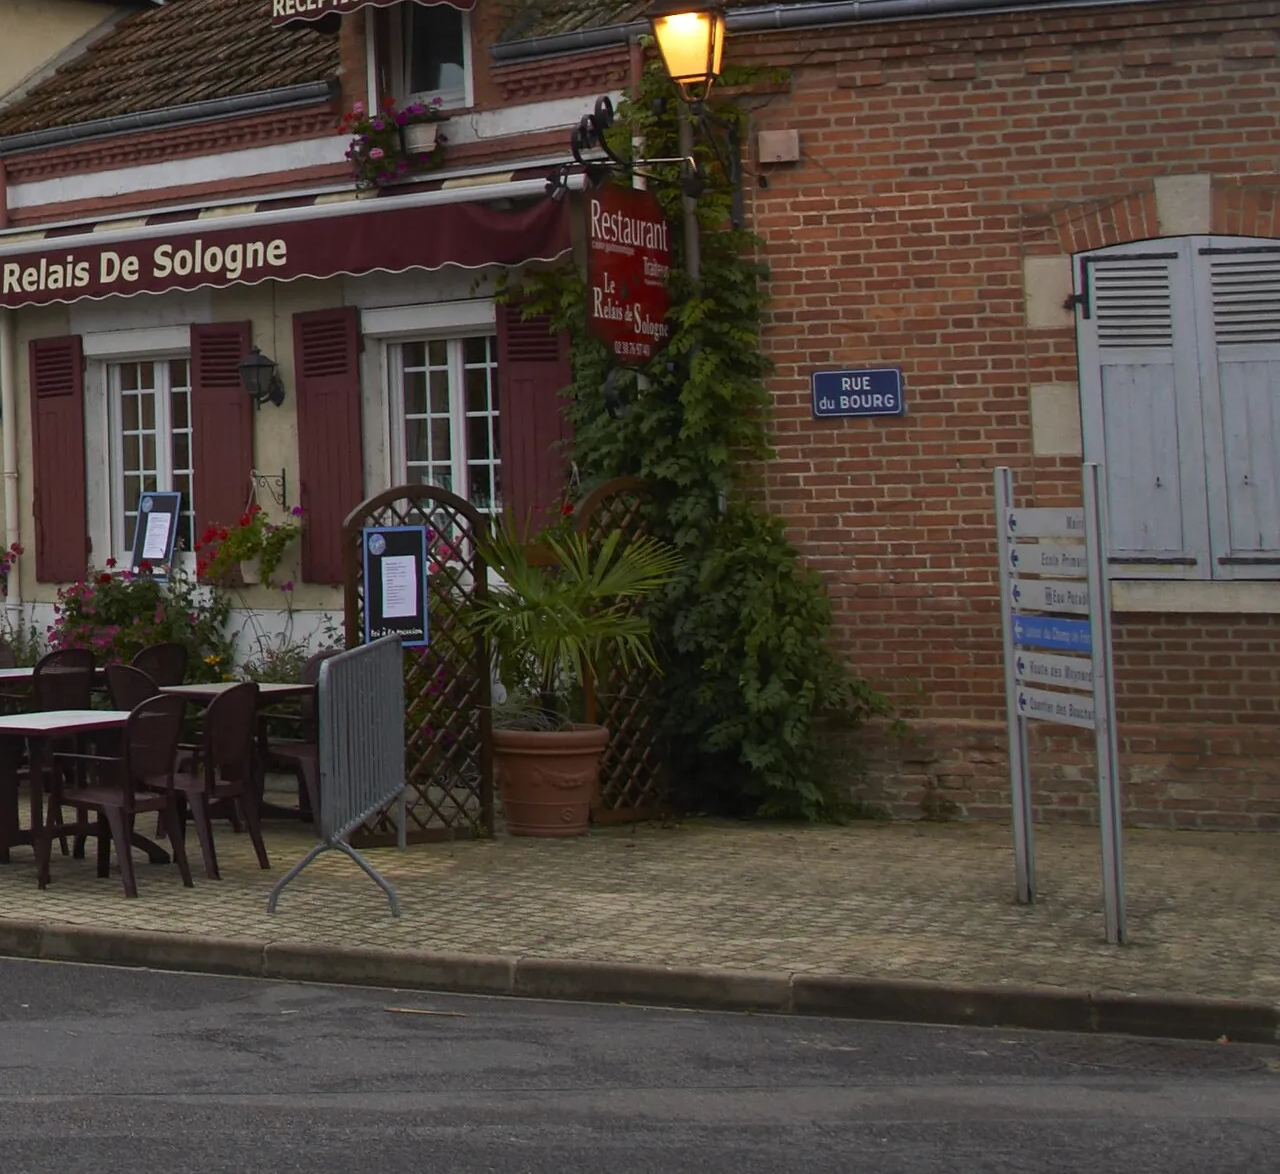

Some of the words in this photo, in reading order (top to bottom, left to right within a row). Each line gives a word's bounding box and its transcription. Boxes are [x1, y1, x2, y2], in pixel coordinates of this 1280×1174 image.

[591, 199, 668, 251] Restaurant
[2, 255, 89, 293] Relais
[100, 251, 139, 283] De
[153, 238, 287, 278] Sologne
[604, 272, 615, 294] Le
[593, 287, 623, 321] Relais
[624, 305, 633, 322] de
[634, 303, 669, 341] Sologne
[819, 396, 835, 410] du
[840, 393, 895, 409] BOURG
[841, 377, 871, 391] RUE
